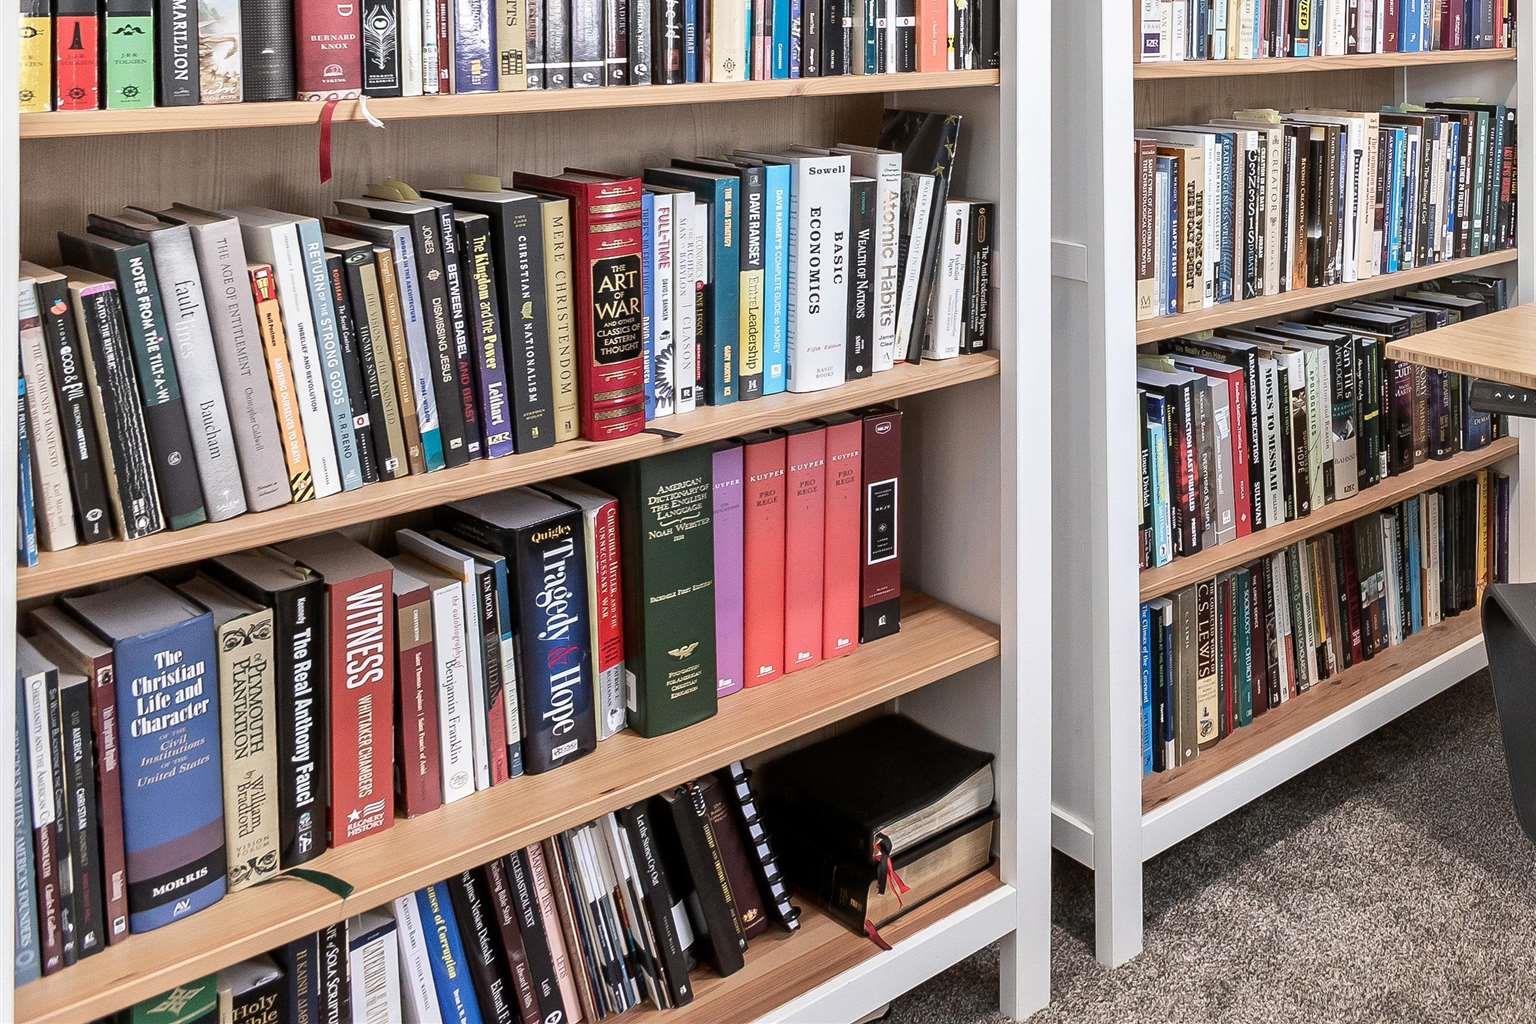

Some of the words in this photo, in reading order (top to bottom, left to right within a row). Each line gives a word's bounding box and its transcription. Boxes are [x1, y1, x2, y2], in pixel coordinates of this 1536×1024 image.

[312, 42, 348, 51] KNOX
[809, 166, 846, 175] Sowell
[1271, 150, 1279, 211] CREATOR
[749, 193, 760, 220] DAVE
[880, 190, 899, 259] Atomic
[216, 238, 231, 260] THE
[441, 213, 455, 254] LEITHART
[473, 235, 487, 252] The
[552, 216, 566, 262] MERE
[748, 221, 760, 265] RAMSEY
[128, 257, 150, 295] NOTES
[220, 262, 234, 283] AGE
[307, 242, 326, 291] RETURN
[473, 253, 491, 300] Kingdom
[808, 207, 822, 315] ECONOMICS
[833, 231, 844, 285] BASIC
[174, 280, 199, 318] fault
[225, 286, 237, 300] OF
[318, 291, 327, 302] OF
[422, 225, 434, 254] JONES
[432, 297, 448, 351] DISMISSING
[440, 353, 452, 383] JESUS
[447, 264, 464, 319] BETWEEN
[599, 275, 638, 293] ART
[879, 264, 896, 326] Habits
[136, 296, 157, 329] FROM
[320, 303, 329, 316] THE
[480, 301, 491, 317] and
[482, 319, 494, 334] the
[517, 235, 531, 299] CHRISTIAN
[524, 322, 538, 403] NATIONALISM
[595, 303, 640, 322] WAR
[142, 331, 160, 352] THE
[227, 303, 251, 377] ENTITLEMENT
[320, 318, 338, 368] STRONG
[455, 321, 468, 358] BABEL
[484, 335, 497, 369] Power
[555, 271, 572, 395] CHRISTENDOM
[1343, 339, 1352, 367] Van
[328, 371, 345, 406] GODS
[459, 360, 470, 384] AND
[1249, 353, 1258, 416] ARMAGEDDON
[1265, 368, 1275, 410] MOSES
[1335, 344, 1344, 400] APOLOGETIC
[1344, 369, 1354, 399] Til's
[463, 387, 475, 424] BEAST
[489, 382, 505, 426] Leithart
[1267, 414, 1276, 430] TO
[199, 399, 224, 460] Baucham
[1251, 418, 1259, 464] DECEPTION
[1268, 435, 1278, 491] MESSIAH
[536, 537, 579, 641] Tragedy
[1198, 584, 1209, 620] C.S.
[293, 628, 312, 659] The
[346, 584, 384, 689] WITNESS
[1199, 620, 1210, 677] LEWIS
[131, 661, 205, 697] Christian
[154, 650, 183, 670] The
[293, 659, 312, 696] Real
[136, 692, 171, 717] Life
[175, 678, 203, 704] and
[248, 659, 264, 756] PLYMOUTH
[443, 660, 458, 714] Benjamin
[542, 666, 581, 736] Hope
[130, 699, 210, 738] Character
[232, 660, 249, 760] PLANTATION
[291, 699, 315, 762] Anthony
[357, 695, 372, 745] WHITTAKER
[446, 716, 461, 765] Franklin
[357, 746, 374, 798] CHAMBERS
[235, 782, 251, 838] Bradford
[250, 775, 264, 828] William
[152, 866, 208, 898] MORRIS
